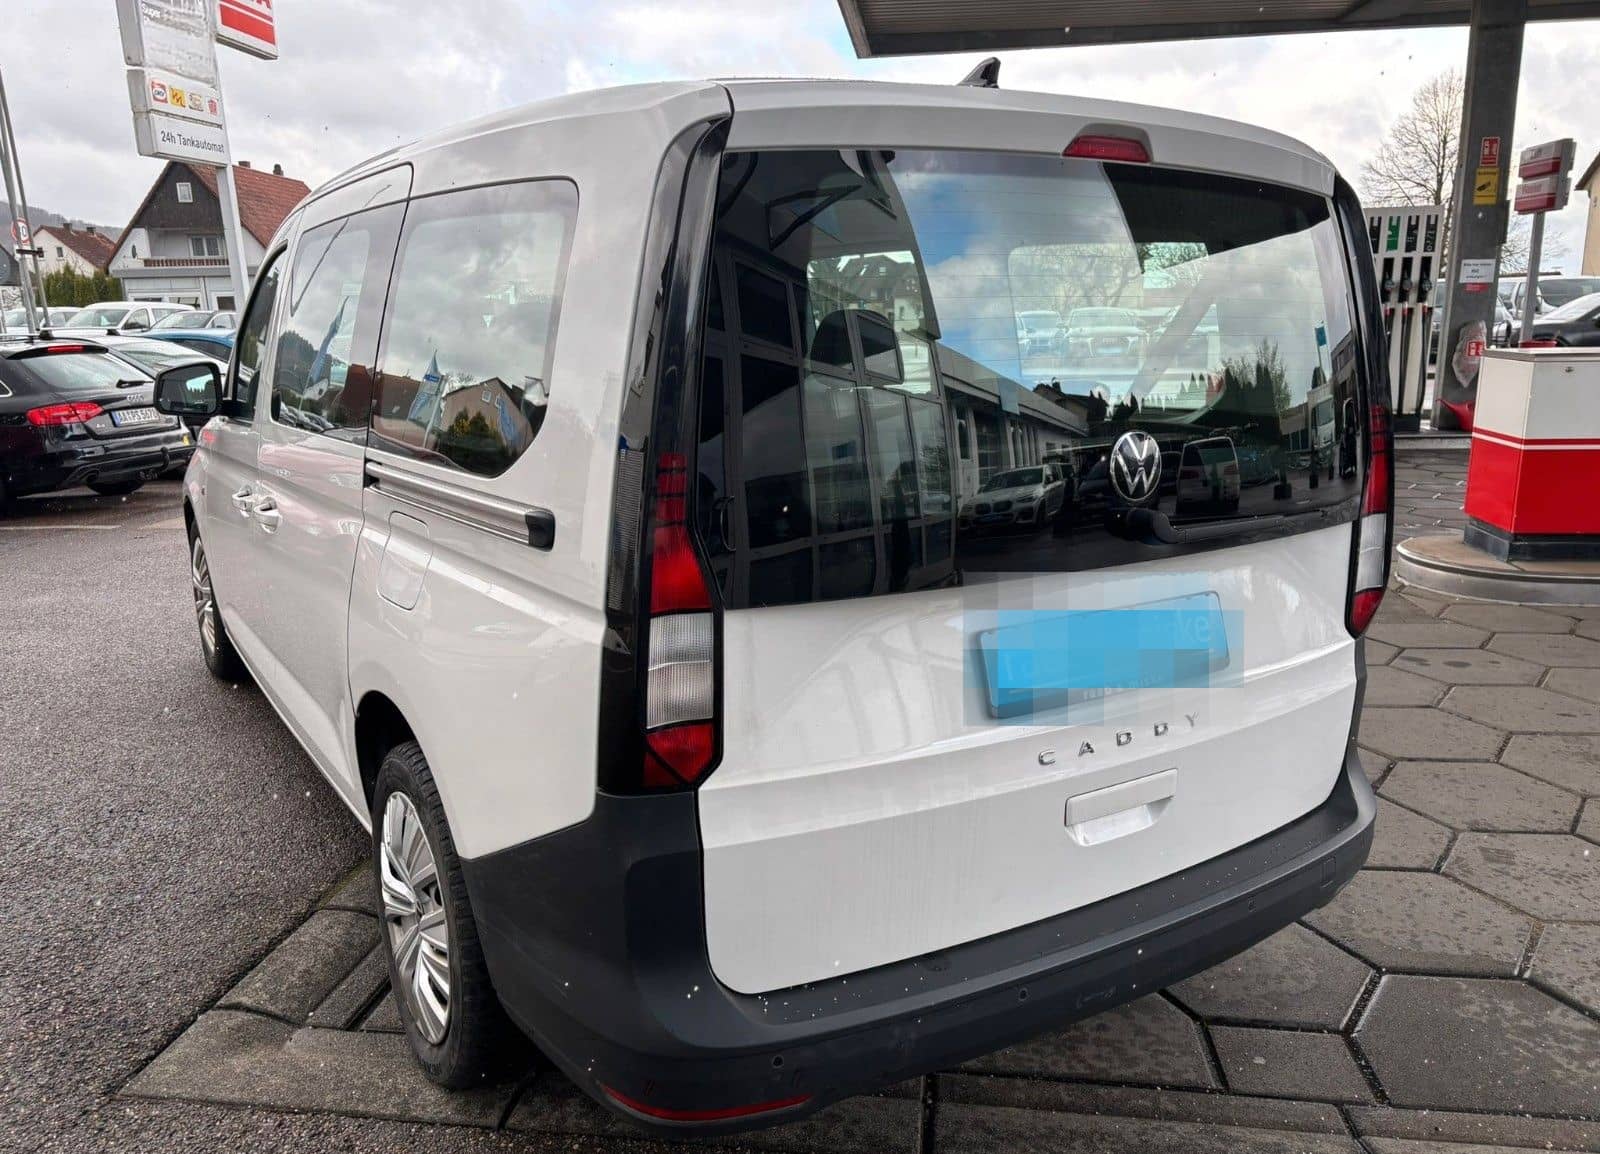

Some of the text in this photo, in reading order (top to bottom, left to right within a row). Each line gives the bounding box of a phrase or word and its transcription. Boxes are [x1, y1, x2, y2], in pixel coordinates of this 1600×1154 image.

[160, 130, 225, 153] 24h Tankautomat
[1038, 711, 1199, 765] CADDY
